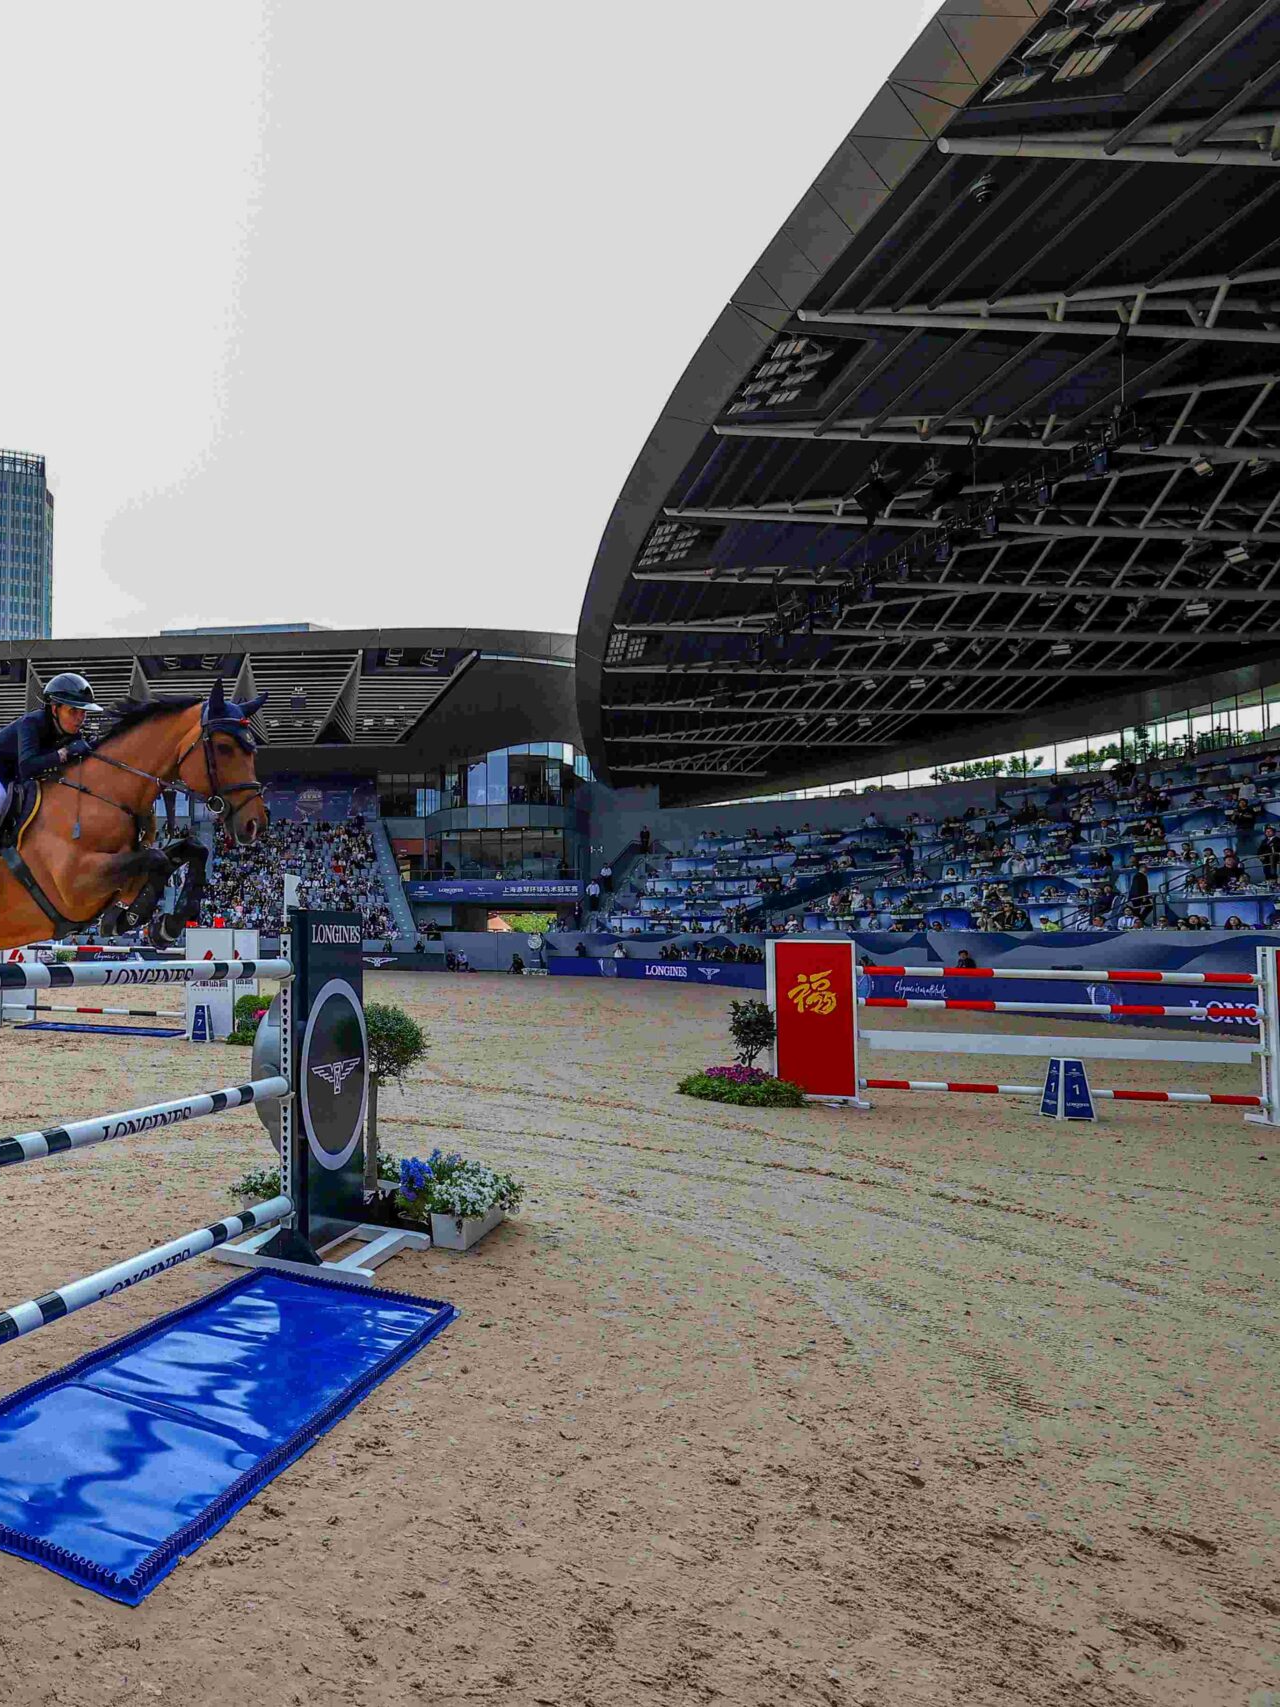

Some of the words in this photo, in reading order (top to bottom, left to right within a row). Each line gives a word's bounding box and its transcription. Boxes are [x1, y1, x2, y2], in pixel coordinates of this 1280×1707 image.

[312, 924, 361, 944] LONGINES
[645, 965, 687, 977] LONGINES
[788, 969, 836, 1014] 福
[197, 1019, 203, 1027] 7
[1050, 1082, 1056, 1093] 1
[1072, 1084, 1080, 1095] 1
